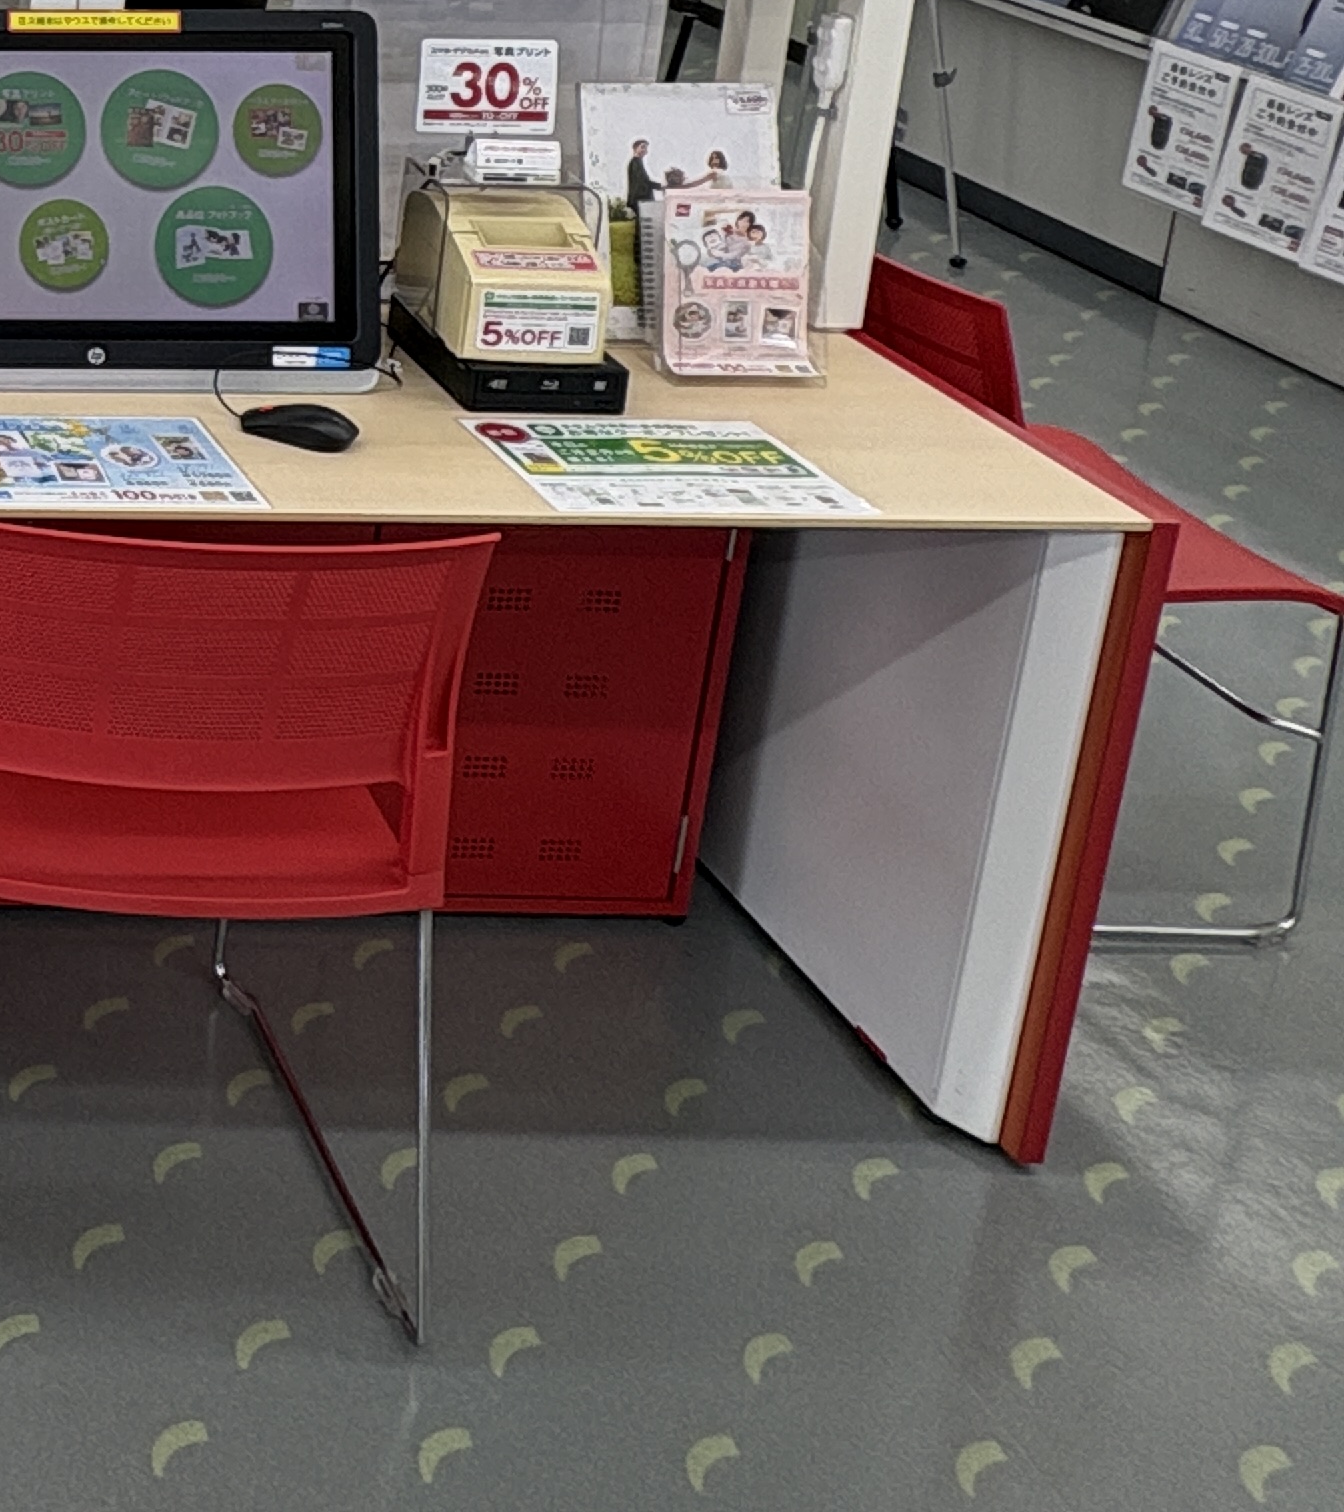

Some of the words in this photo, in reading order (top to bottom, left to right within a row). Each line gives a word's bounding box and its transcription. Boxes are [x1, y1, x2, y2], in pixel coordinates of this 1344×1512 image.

[494, 46, 552, 57] 写真プリント
[450, 61, 520, 110] 30
[518, 96, 550, 110] OFF
[480, 320, 564, 347] 5%OFF
